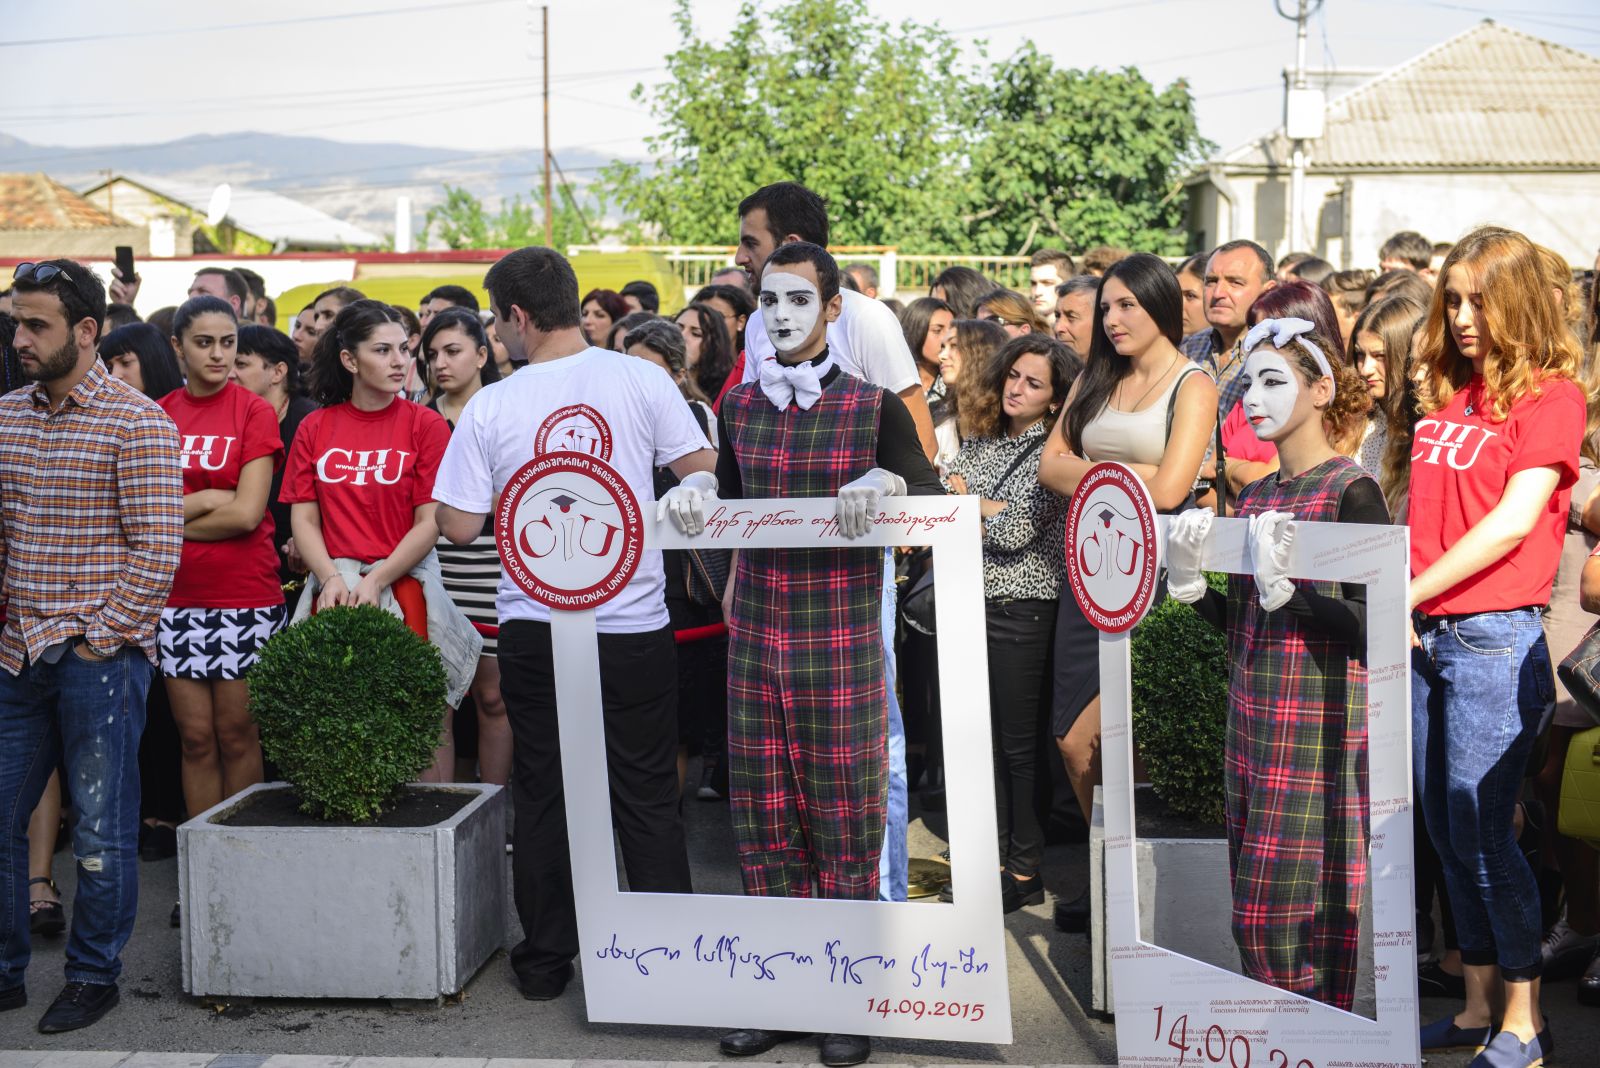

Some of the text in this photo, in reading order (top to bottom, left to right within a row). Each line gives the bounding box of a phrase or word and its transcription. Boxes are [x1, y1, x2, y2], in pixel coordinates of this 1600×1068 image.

[180, 435, 237, 471] IU
[316, 447, 410, 486] CIU
[335, 463, 387, 471] www.ciu.edu.ge
[1410, 419, 1498, 471] CIU
[520, 456, 590, 484] საერთაშორისო
[592, 463, 638, 524] უნივერსიტეტი
[502, 536, 638, 605] CAUCASUS INTERNATIONAL UNIVERSITY
[1069, 553, 1154, 628] CAUCASUS INTERNATIONAL UNIVERSITY
[866, 997, 986, 1022] 14.09.2015
